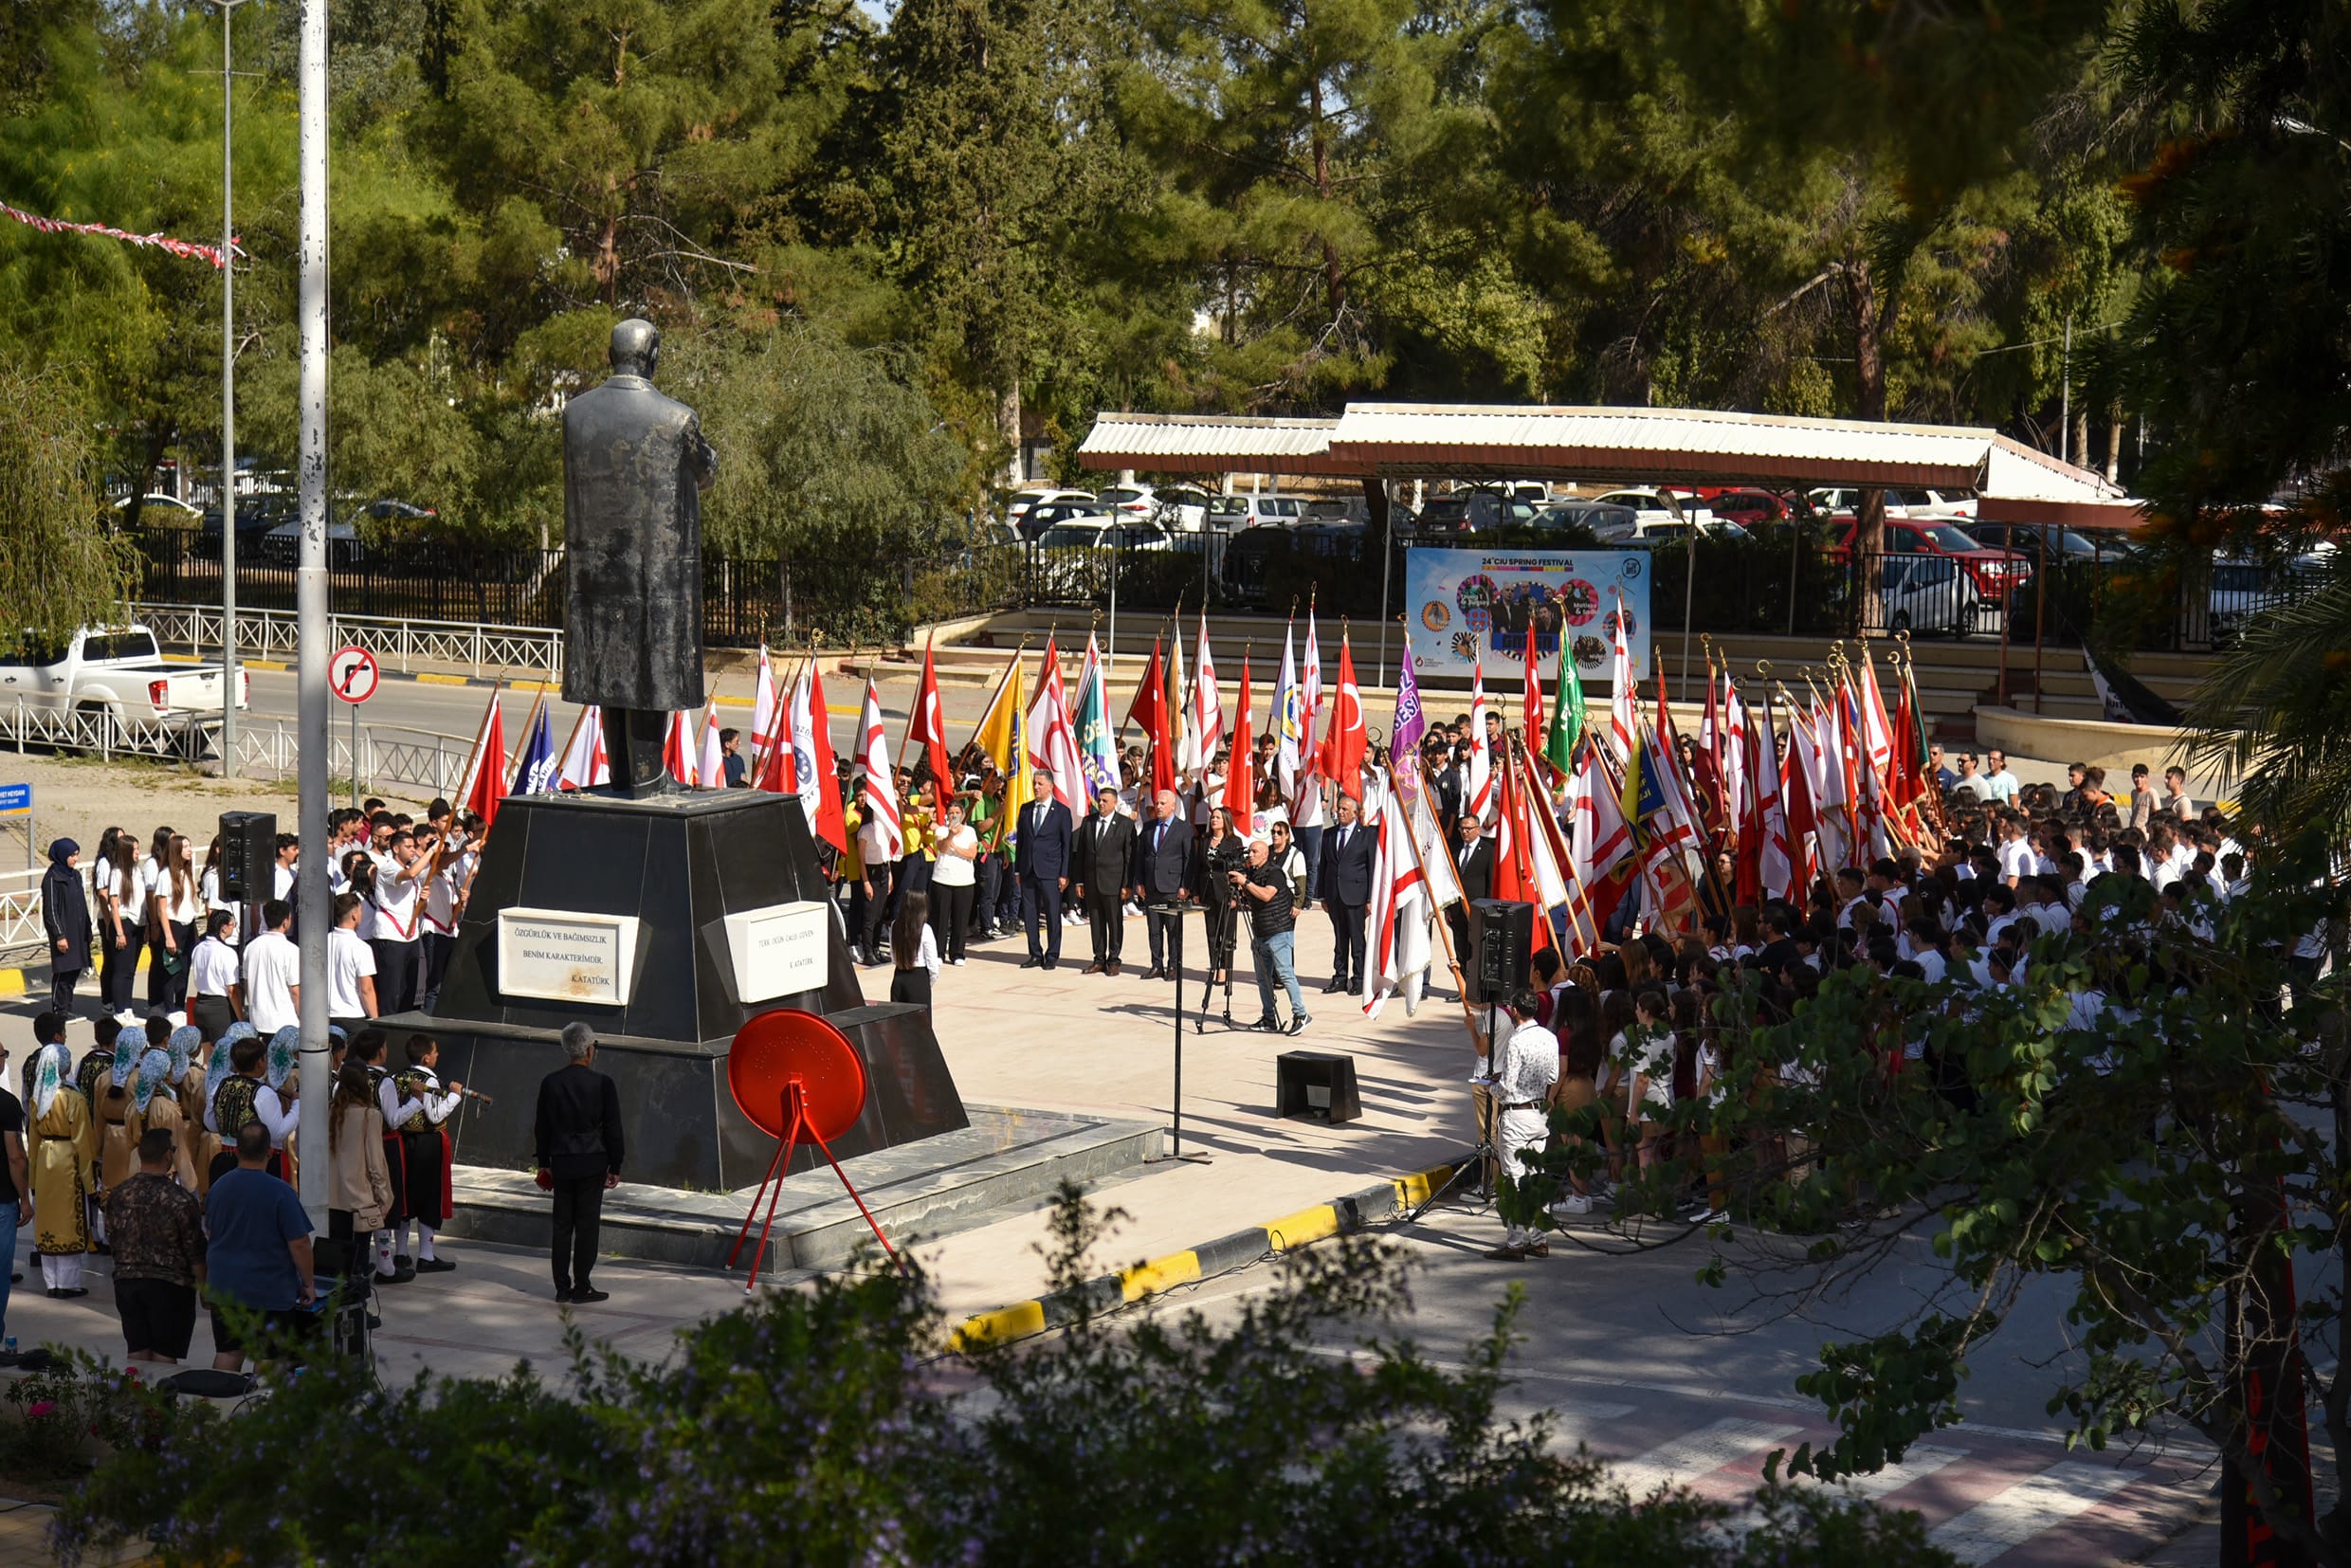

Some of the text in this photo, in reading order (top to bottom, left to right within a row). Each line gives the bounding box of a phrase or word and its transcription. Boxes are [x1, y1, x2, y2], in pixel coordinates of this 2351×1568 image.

[514, 927, 608, 944] ÖZGÜRLÜK VE BAĞIMSIZLIK
[522, 949, 545, 959] BENİM
